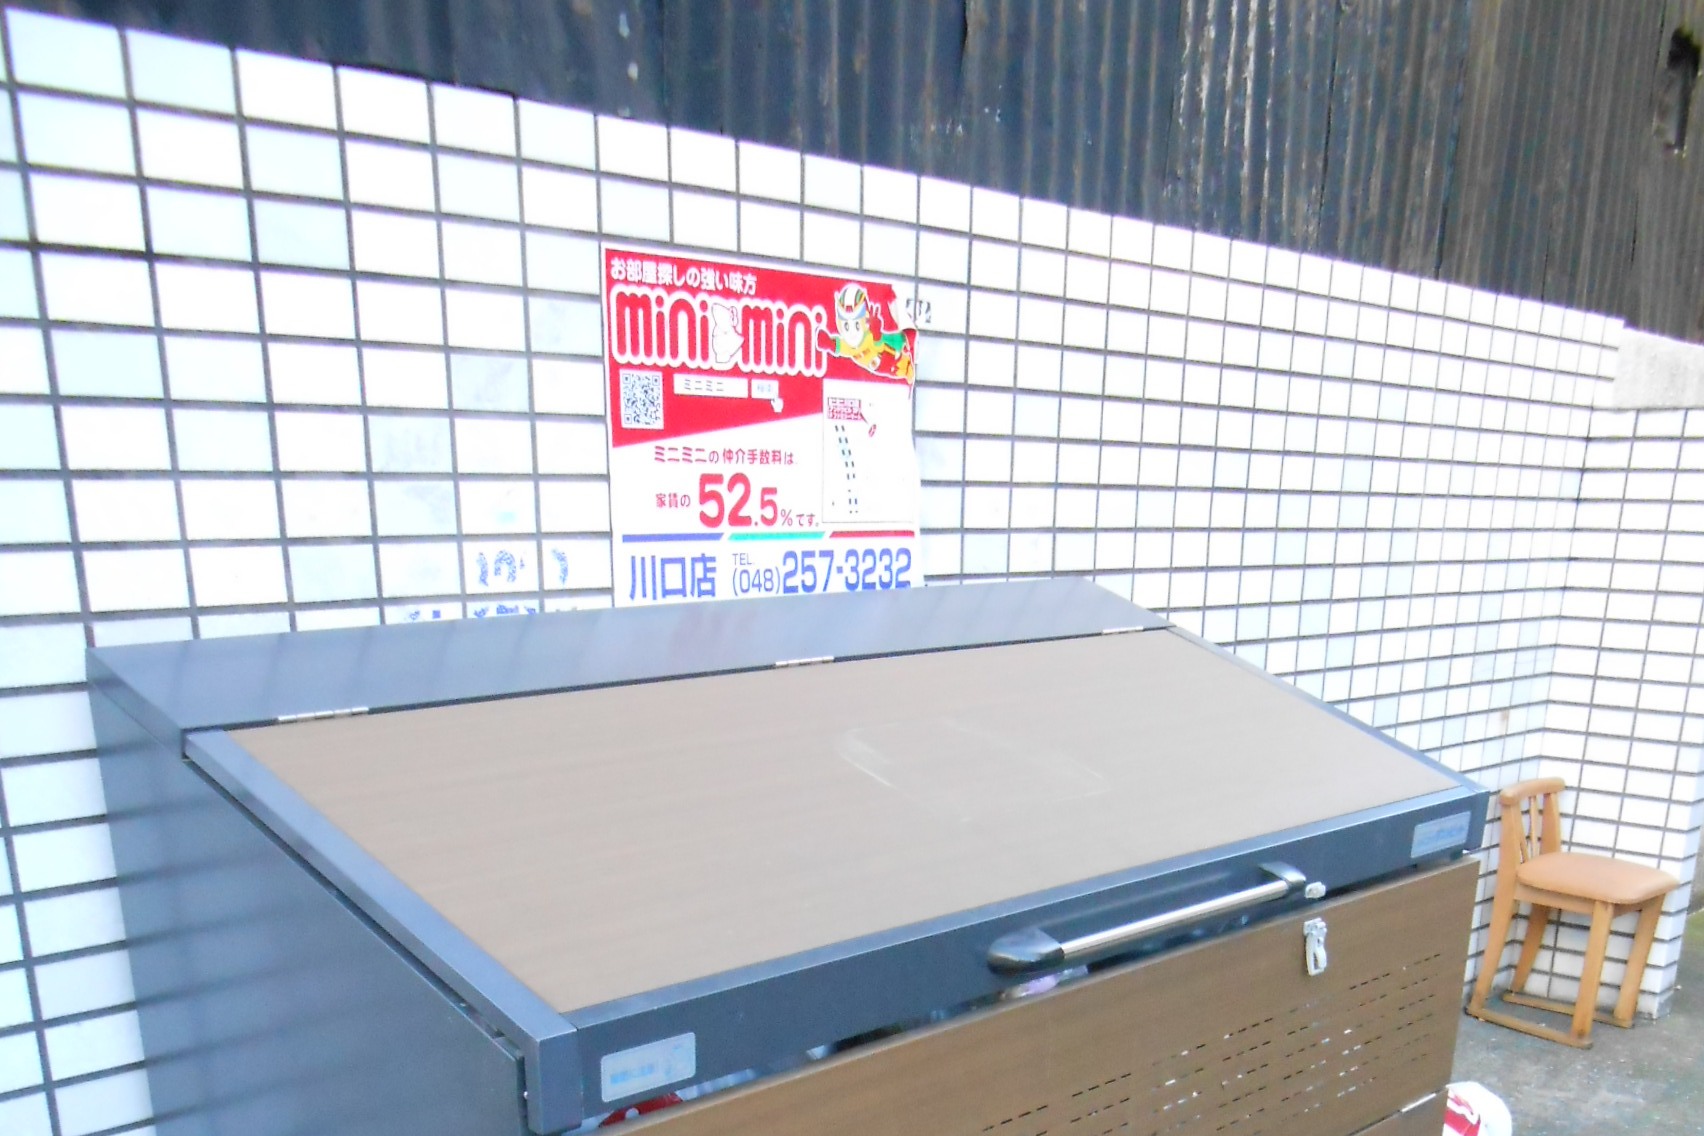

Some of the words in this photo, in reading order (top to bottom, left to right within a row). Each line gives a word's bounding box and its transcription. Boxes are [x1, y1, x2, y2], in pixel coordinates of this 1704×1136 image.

[611, 258, 757, 295] お部屋探しの強い味方
[616, 291, 709, 363] mini
[742, 305, 823, 371] mini
[684, 379, 724, 392] ミニミニ
[654, 445, 794, 465] ミニミニの仲介手数料は
[629, 553, 717, 600] 川口店
